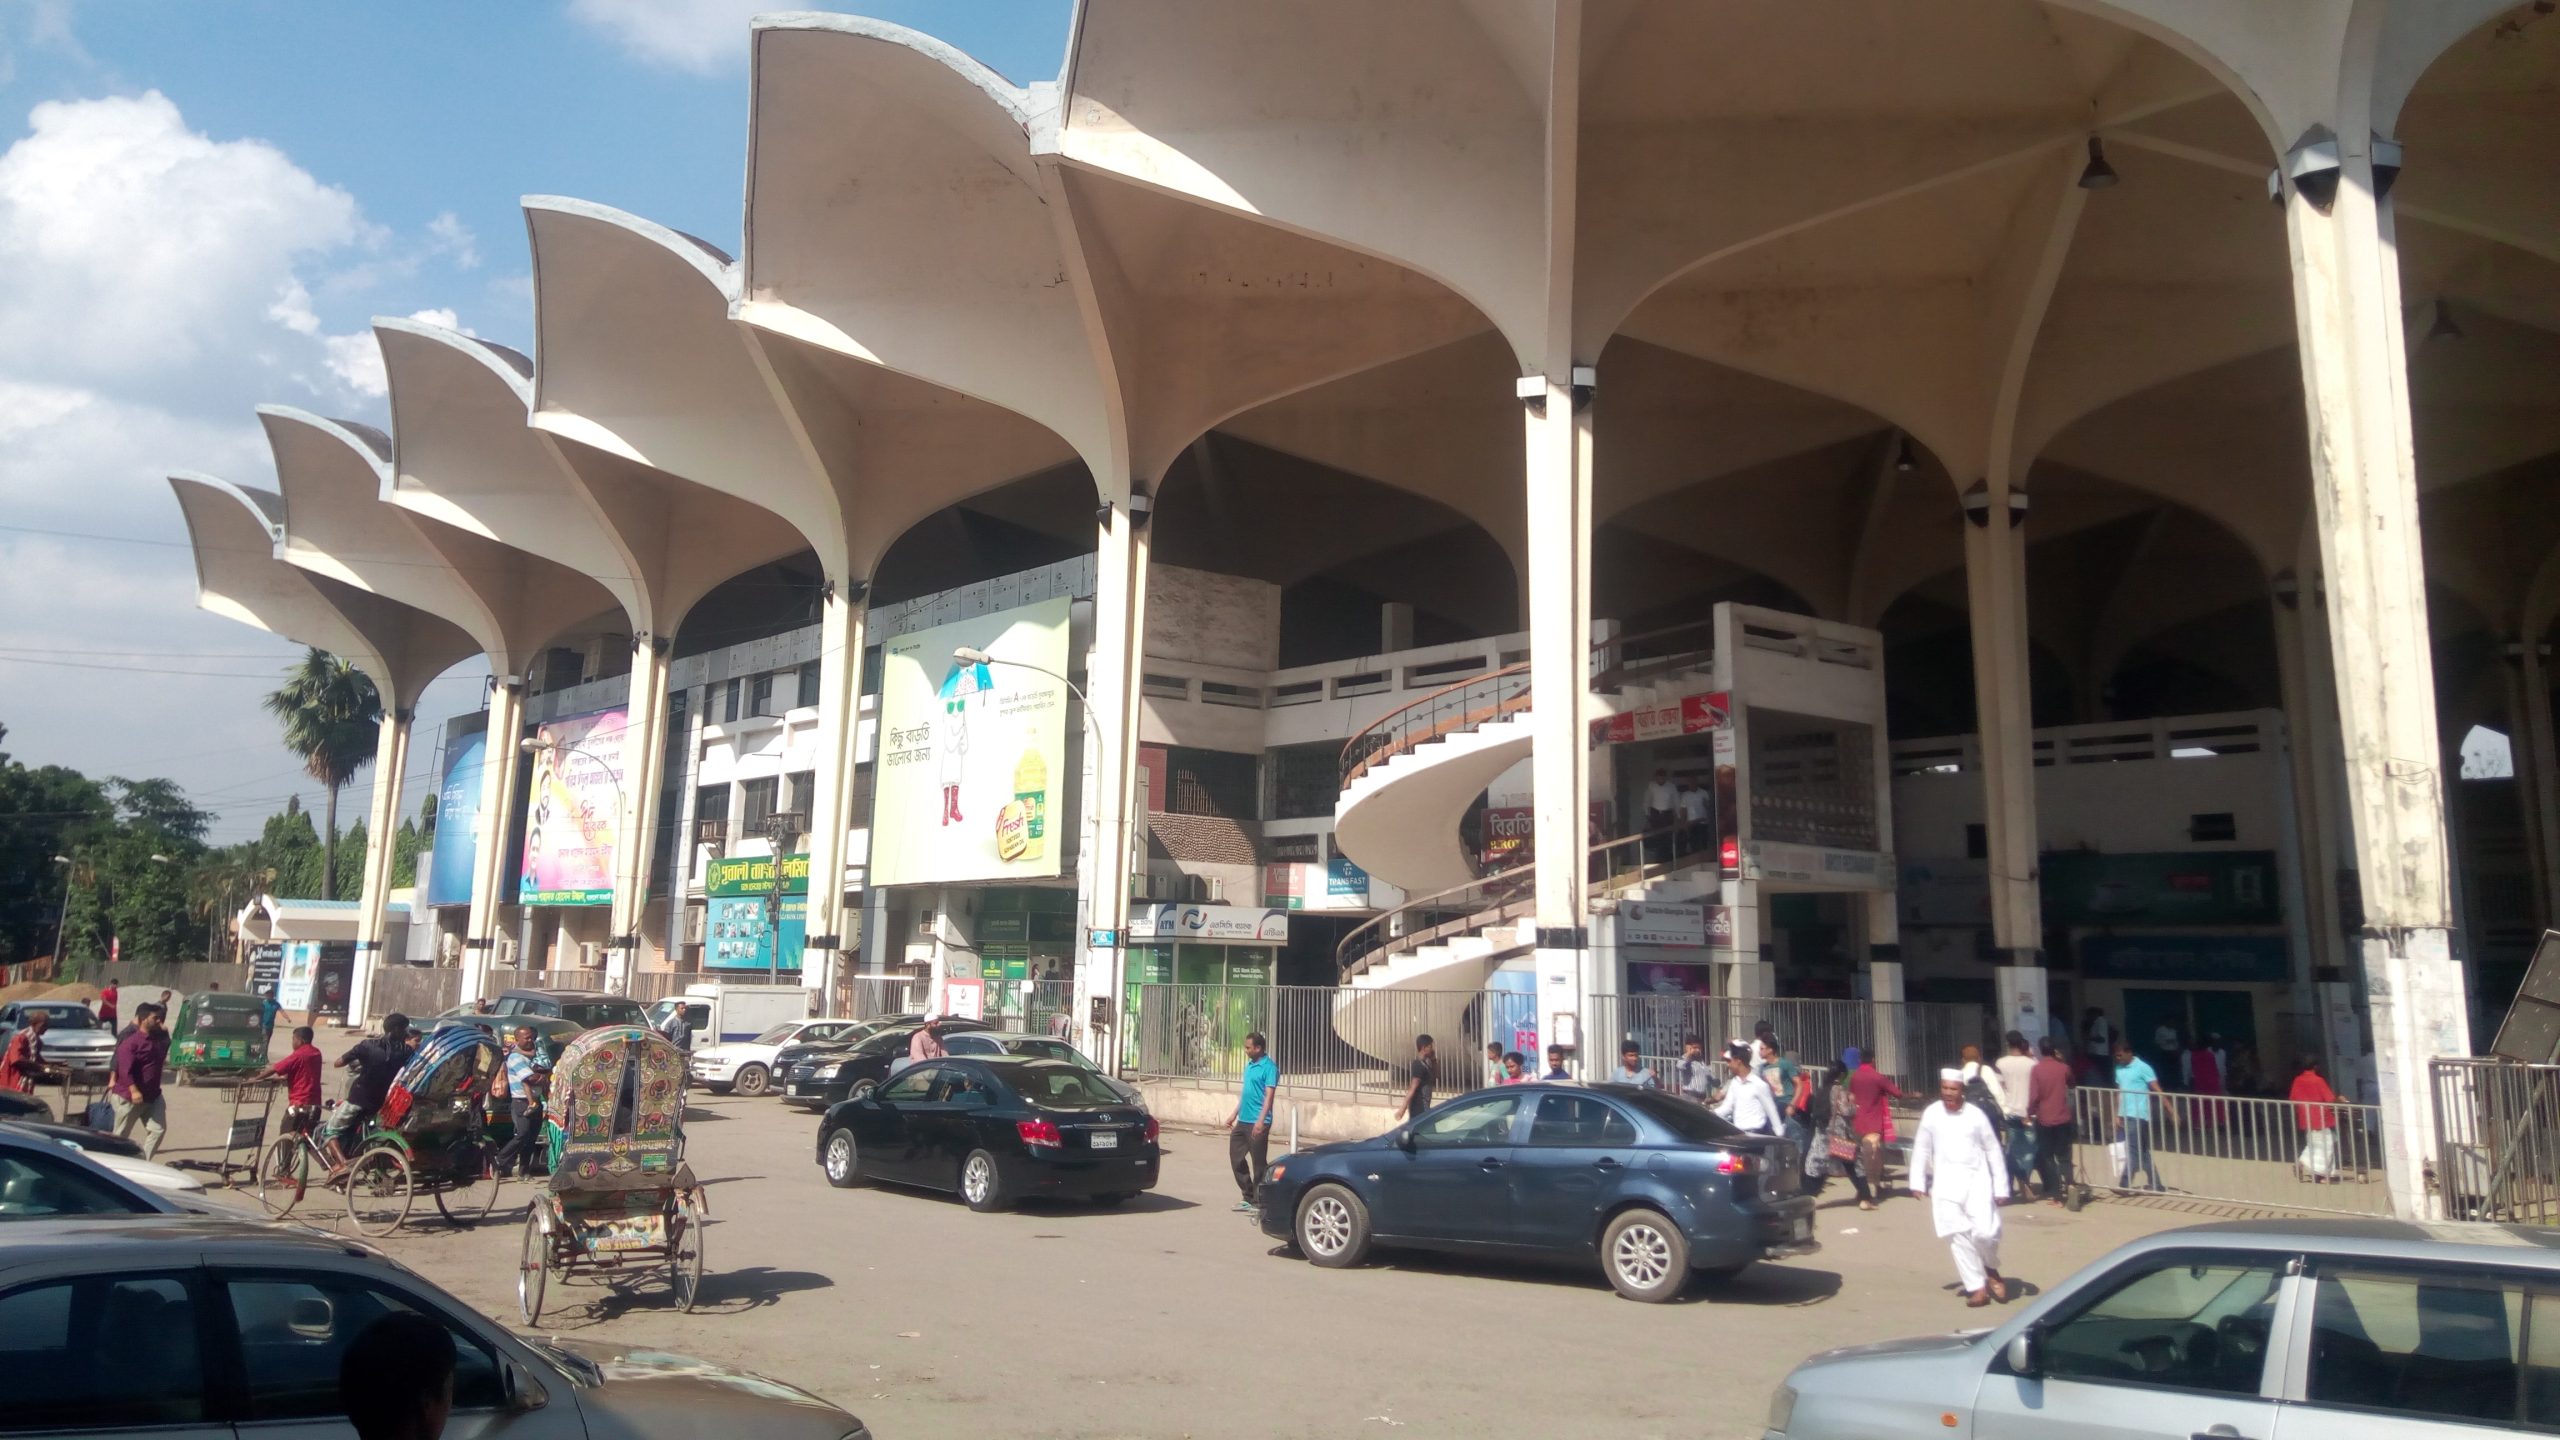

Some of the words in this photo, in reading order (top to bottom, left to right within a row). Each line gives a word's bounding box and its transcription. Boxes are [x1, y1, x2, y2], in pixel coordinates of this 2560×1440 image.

[890, 727, 904, 749] কিছু
[906, 721, 931, 744] বাড়তি
[887, 750, 912, 766] ভালোর
[914, 747, 931, 761] জন্য
[1490, 812, 1535, 836] বিরতি
[1160, 920, 1174, 930] ATM
[1516, 1031, 1537, 1051] FR
